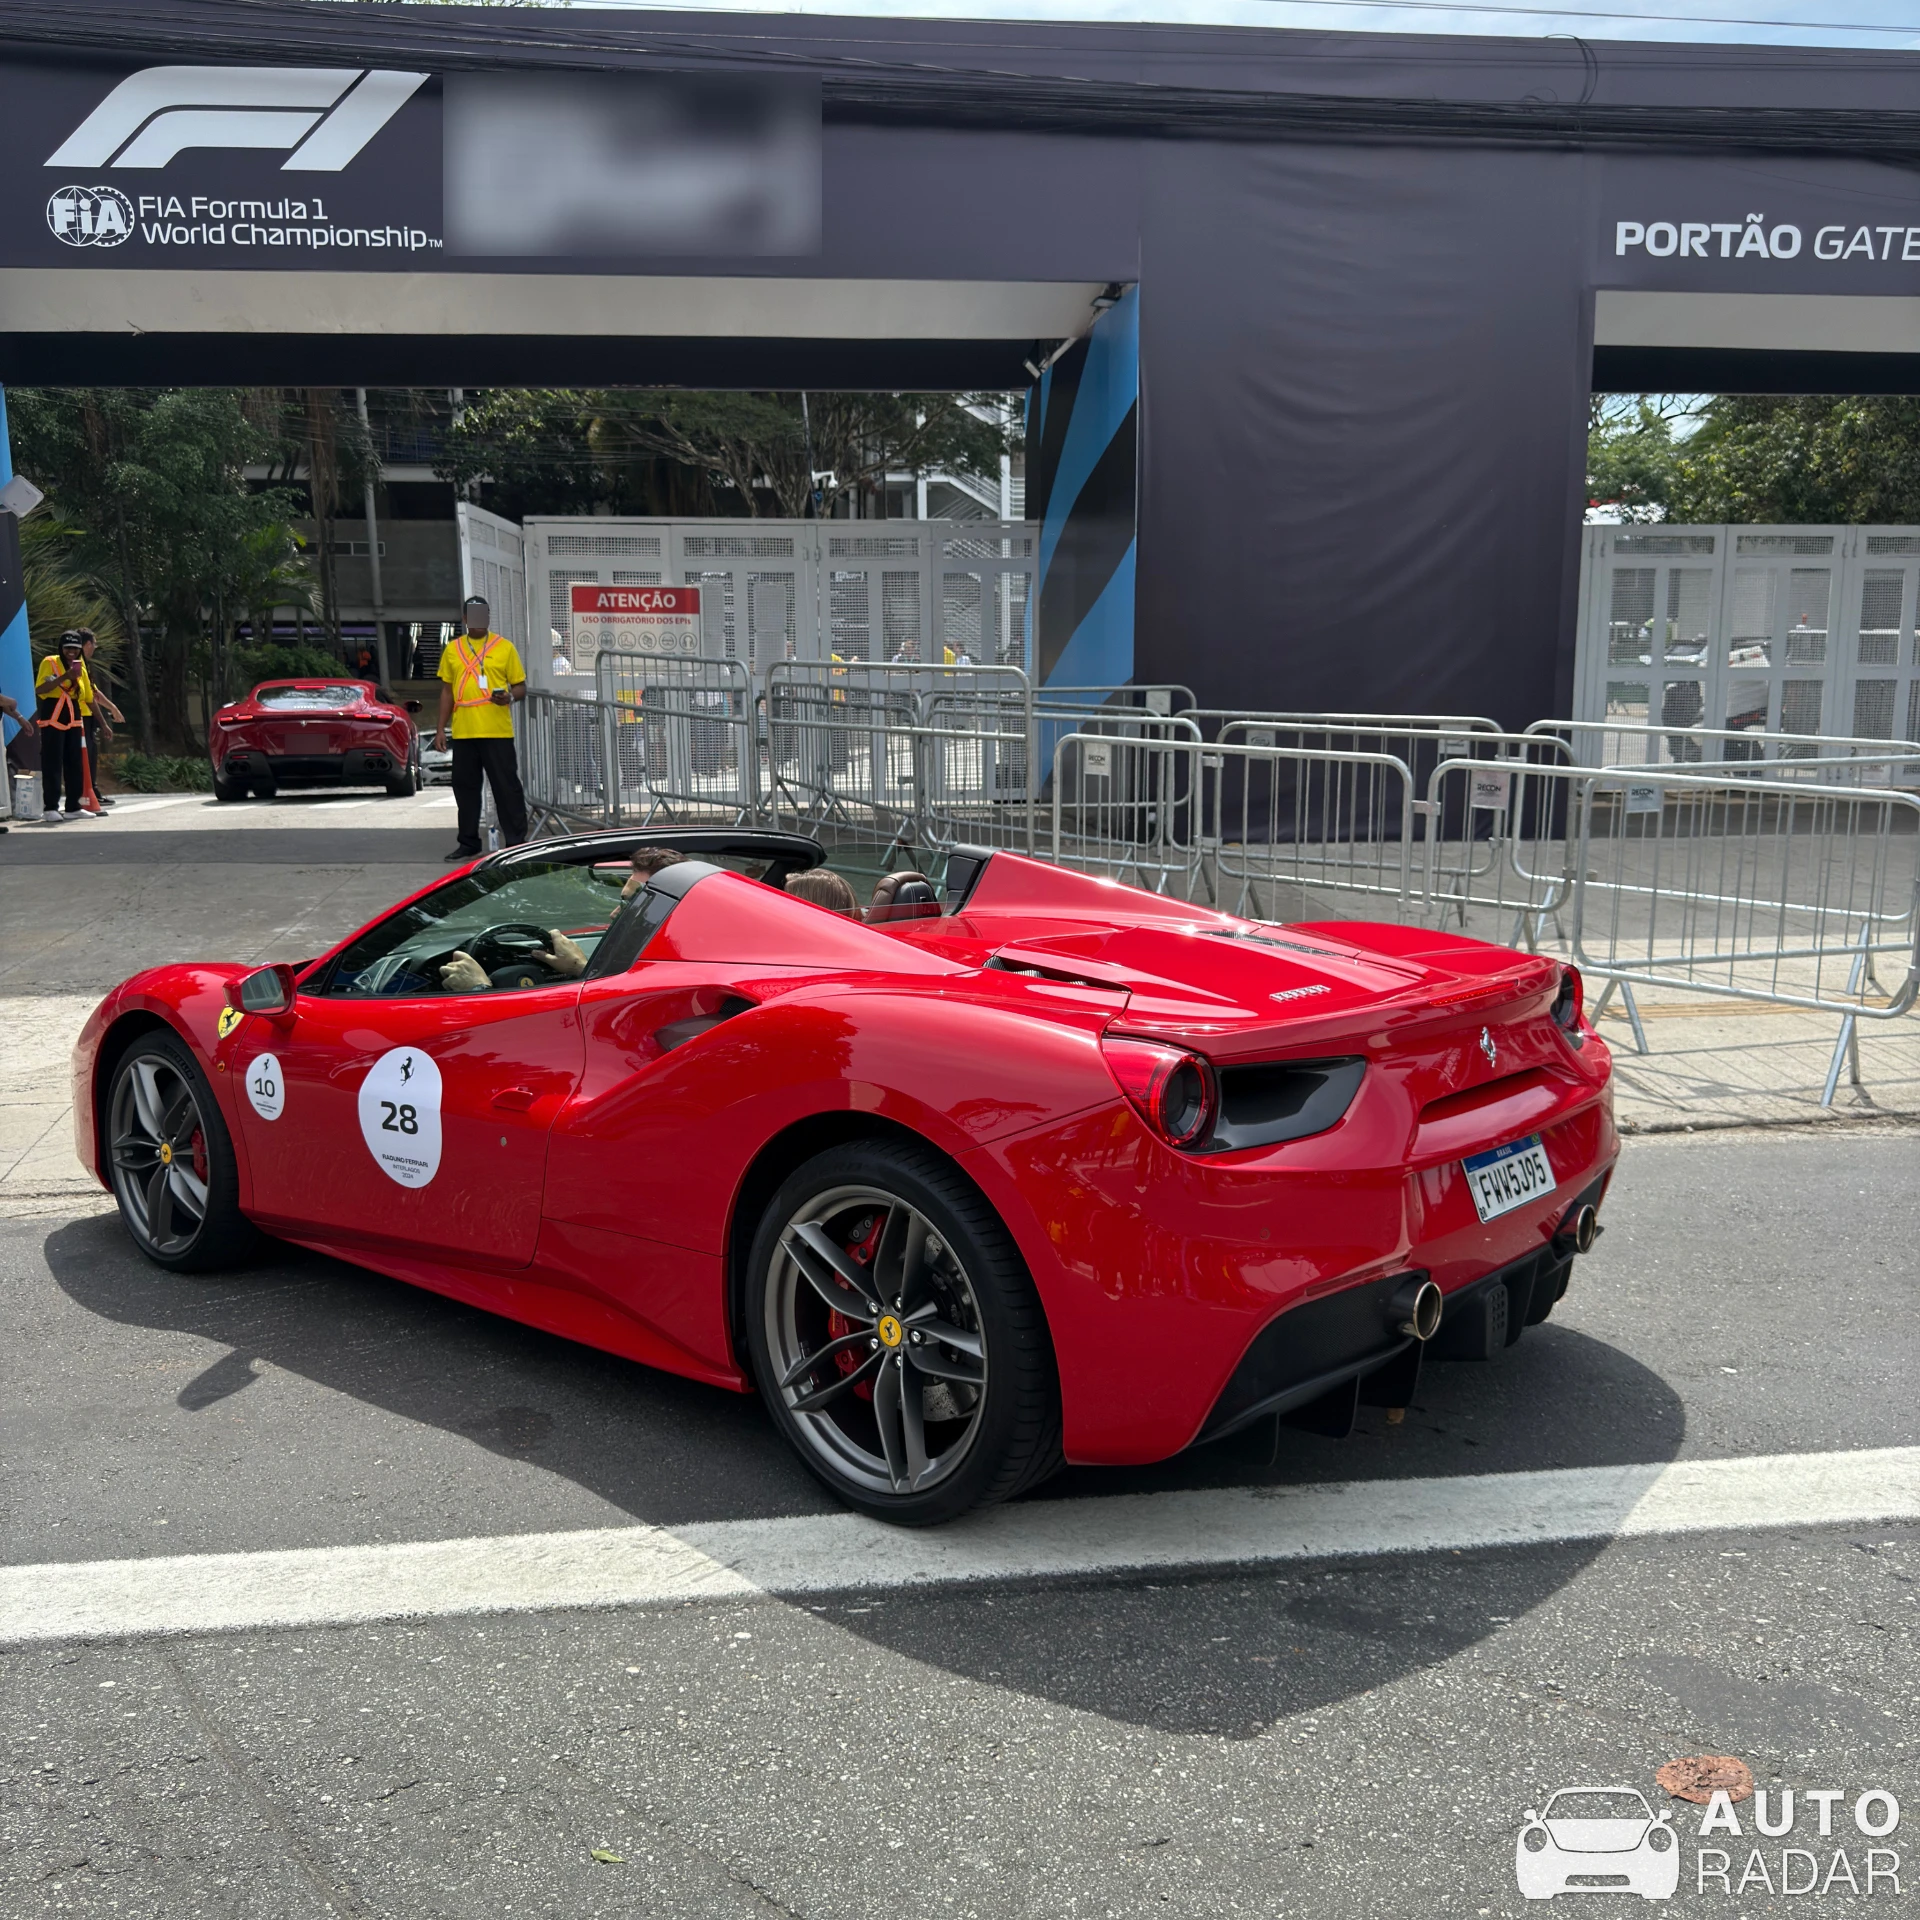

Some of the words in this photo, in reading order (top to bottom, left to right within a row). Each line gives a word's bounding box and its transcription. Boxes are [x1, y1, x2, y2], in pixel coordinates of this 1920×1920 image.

[139, 196, 186, 218] FIA
[191, 197, 307, 220] Formula
[312, 198, 328, 220] 1
[141, 223, 226, 245] World
[1615, 213, 1802, 259] PORTÃO
[1814, 225, 1920, 260] GATE
[597, 591, 677, 612] ATENÇÃO
[582, 616, 600, 624] USO
[601, 615, 655, 624] OBRIGATÓRIO
[656, 616, 674, 624] DOS
[254, 1078, 275, 1098] 10
[380, 1100, 419, 1135] 28
[1478, 1152, 1547, 1209] FWW5J95
